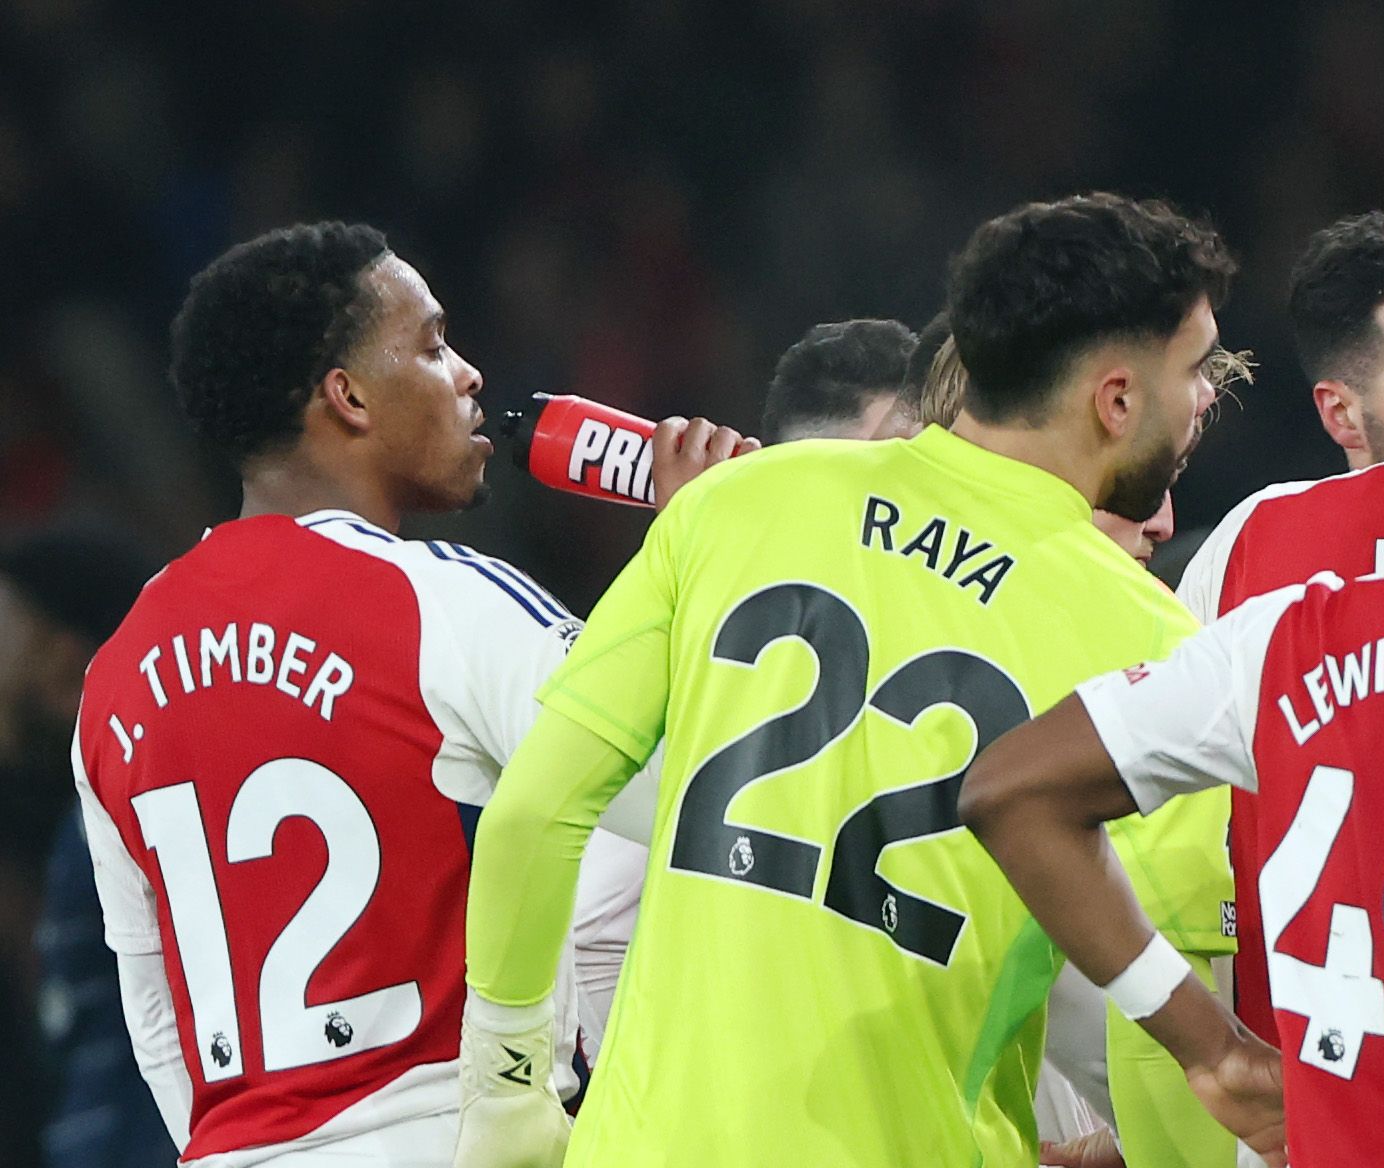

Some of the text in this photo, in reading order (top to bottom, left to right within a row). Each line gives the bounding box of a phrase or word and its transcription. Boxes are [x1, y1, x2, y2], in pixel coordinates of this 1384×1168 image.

[568, 417, 656, 505] PRI
[861, 494, 1016, 607] RAYA
[108, 622, 354, 764] J. TIMBER
[668, 580, 1034, 968] 22
[130, 756, 423, 1084] 12
